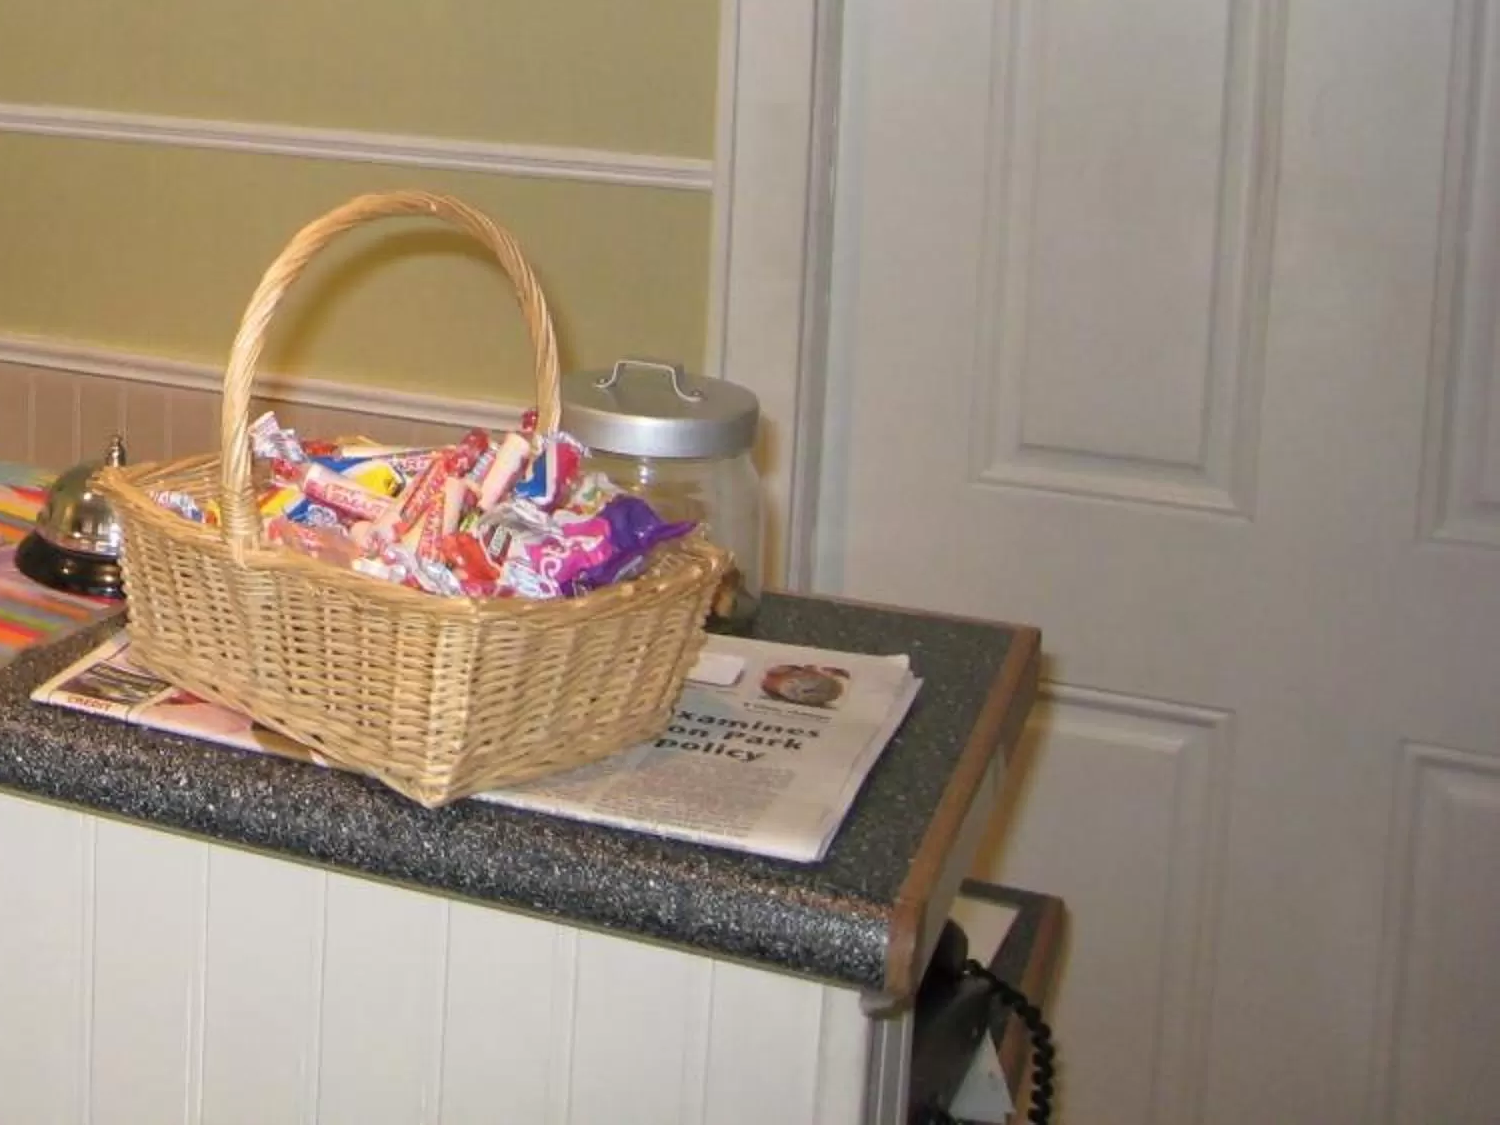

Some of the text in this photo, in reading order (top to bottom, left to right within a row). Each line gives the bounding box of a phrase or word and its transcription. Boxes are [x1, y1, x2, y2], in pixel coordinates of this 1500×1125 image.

[671, 707, 820, 739] xamines
[653, 737, 767, 763] policy
[668, 724, 803, 750] on Park
